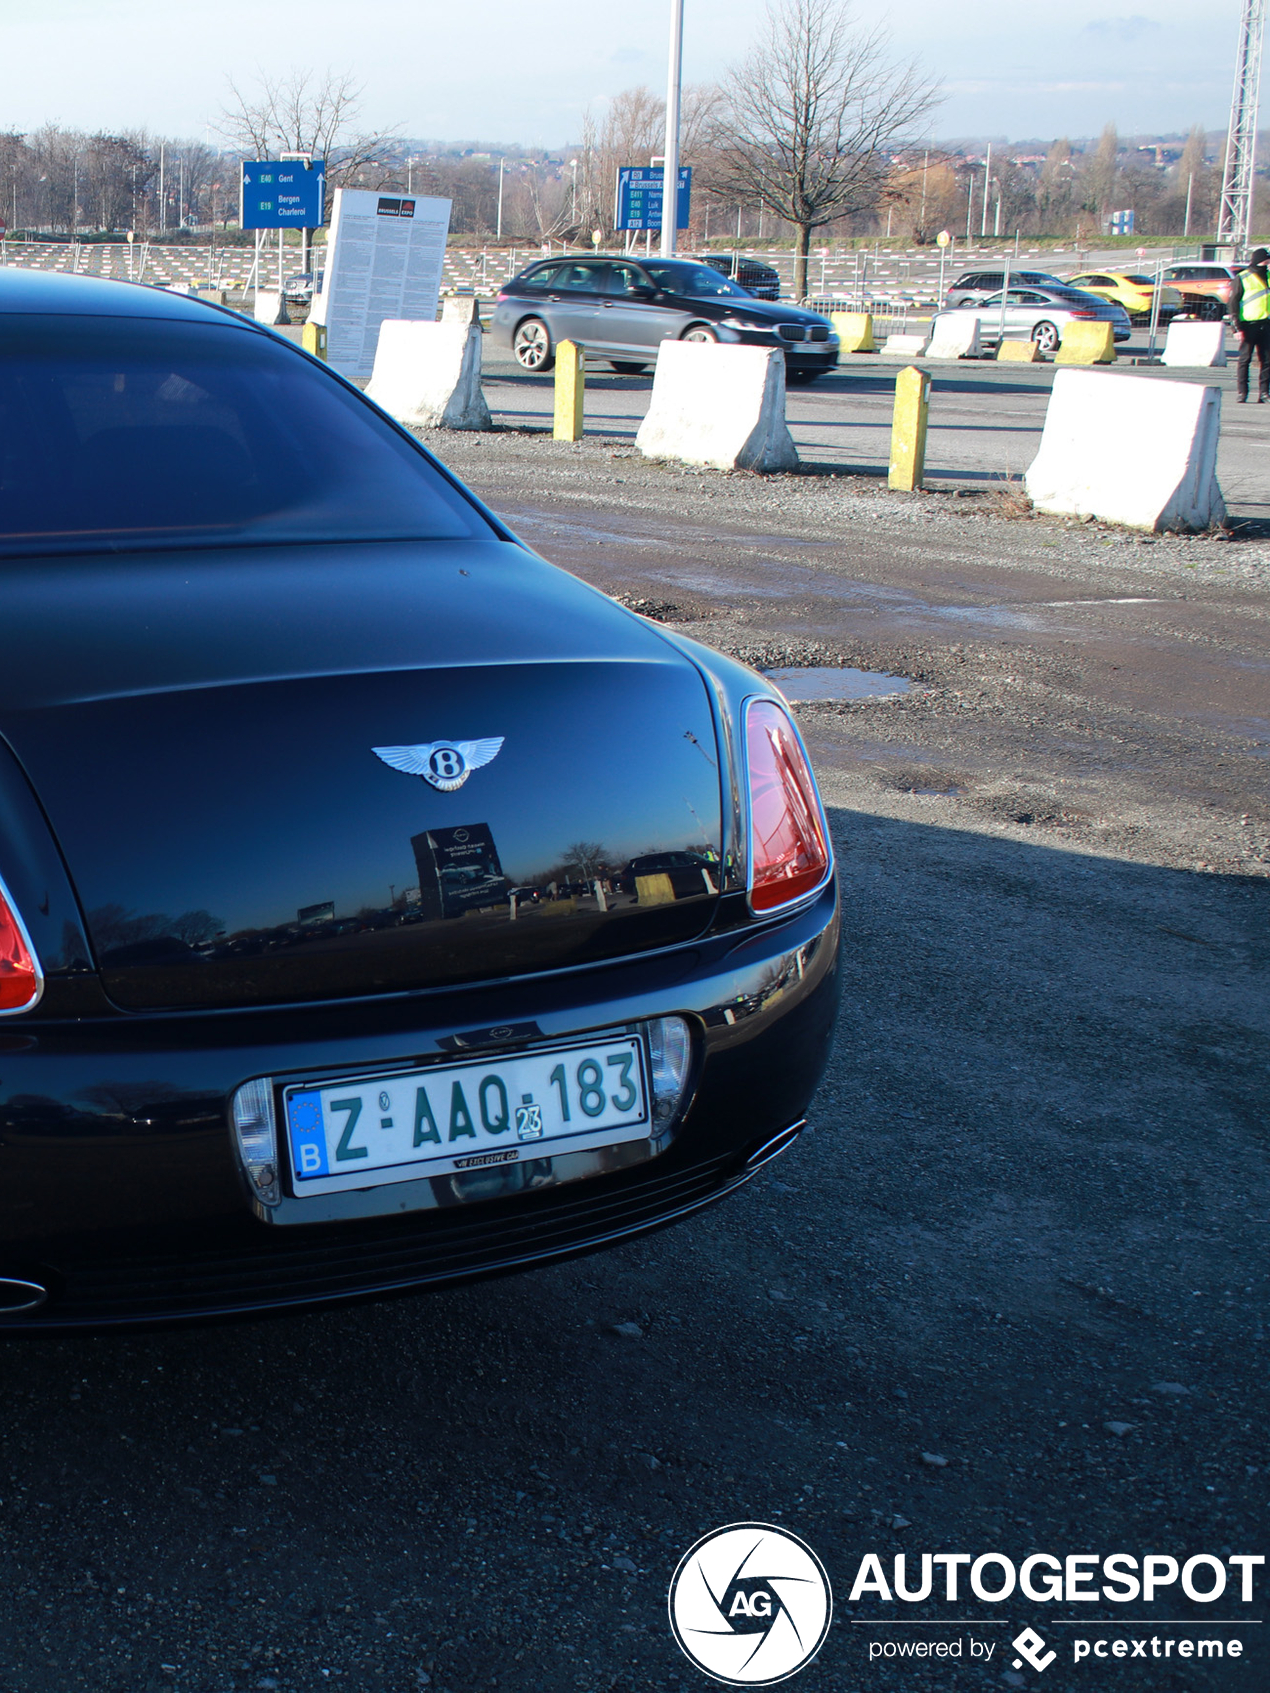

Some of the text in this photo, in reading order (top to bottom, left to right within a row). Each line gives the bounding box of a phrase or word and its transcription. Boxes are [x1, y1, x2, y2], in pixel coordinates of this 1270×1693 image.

[260, 174, 293, 183] E40 Gent
[278, 195, 300, 205] Bergen
[278, 208, 306, 216] Charleroi
[300, 1144, 321, 1172] B
[469, 1154, 504, 1166] EXCLUSIVE
